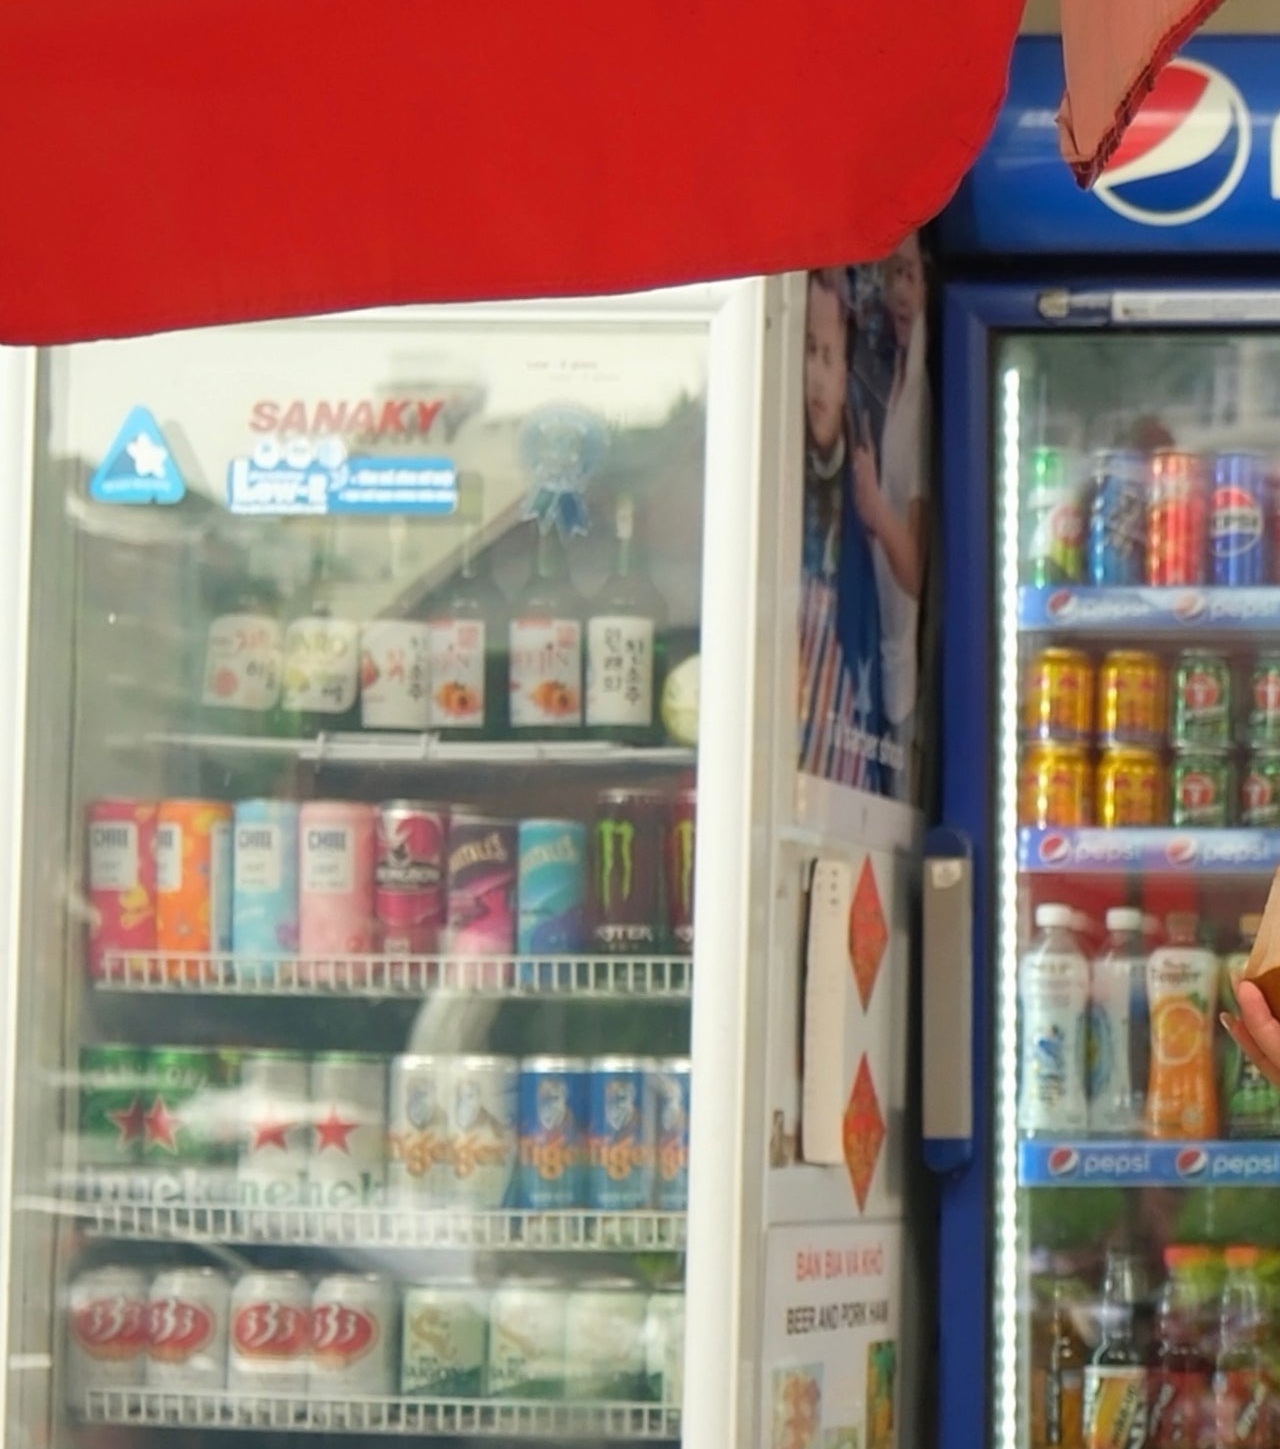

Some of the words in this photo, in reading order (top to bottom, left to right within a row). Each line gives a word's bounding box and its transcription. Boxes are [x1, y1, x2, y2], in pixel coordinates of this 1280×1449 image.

[249, 399, 443, 435] SANAKY
[1083, 1152, 1149, 1175] pepsi
[1212, 1153, 1280, 1176] pepsi
